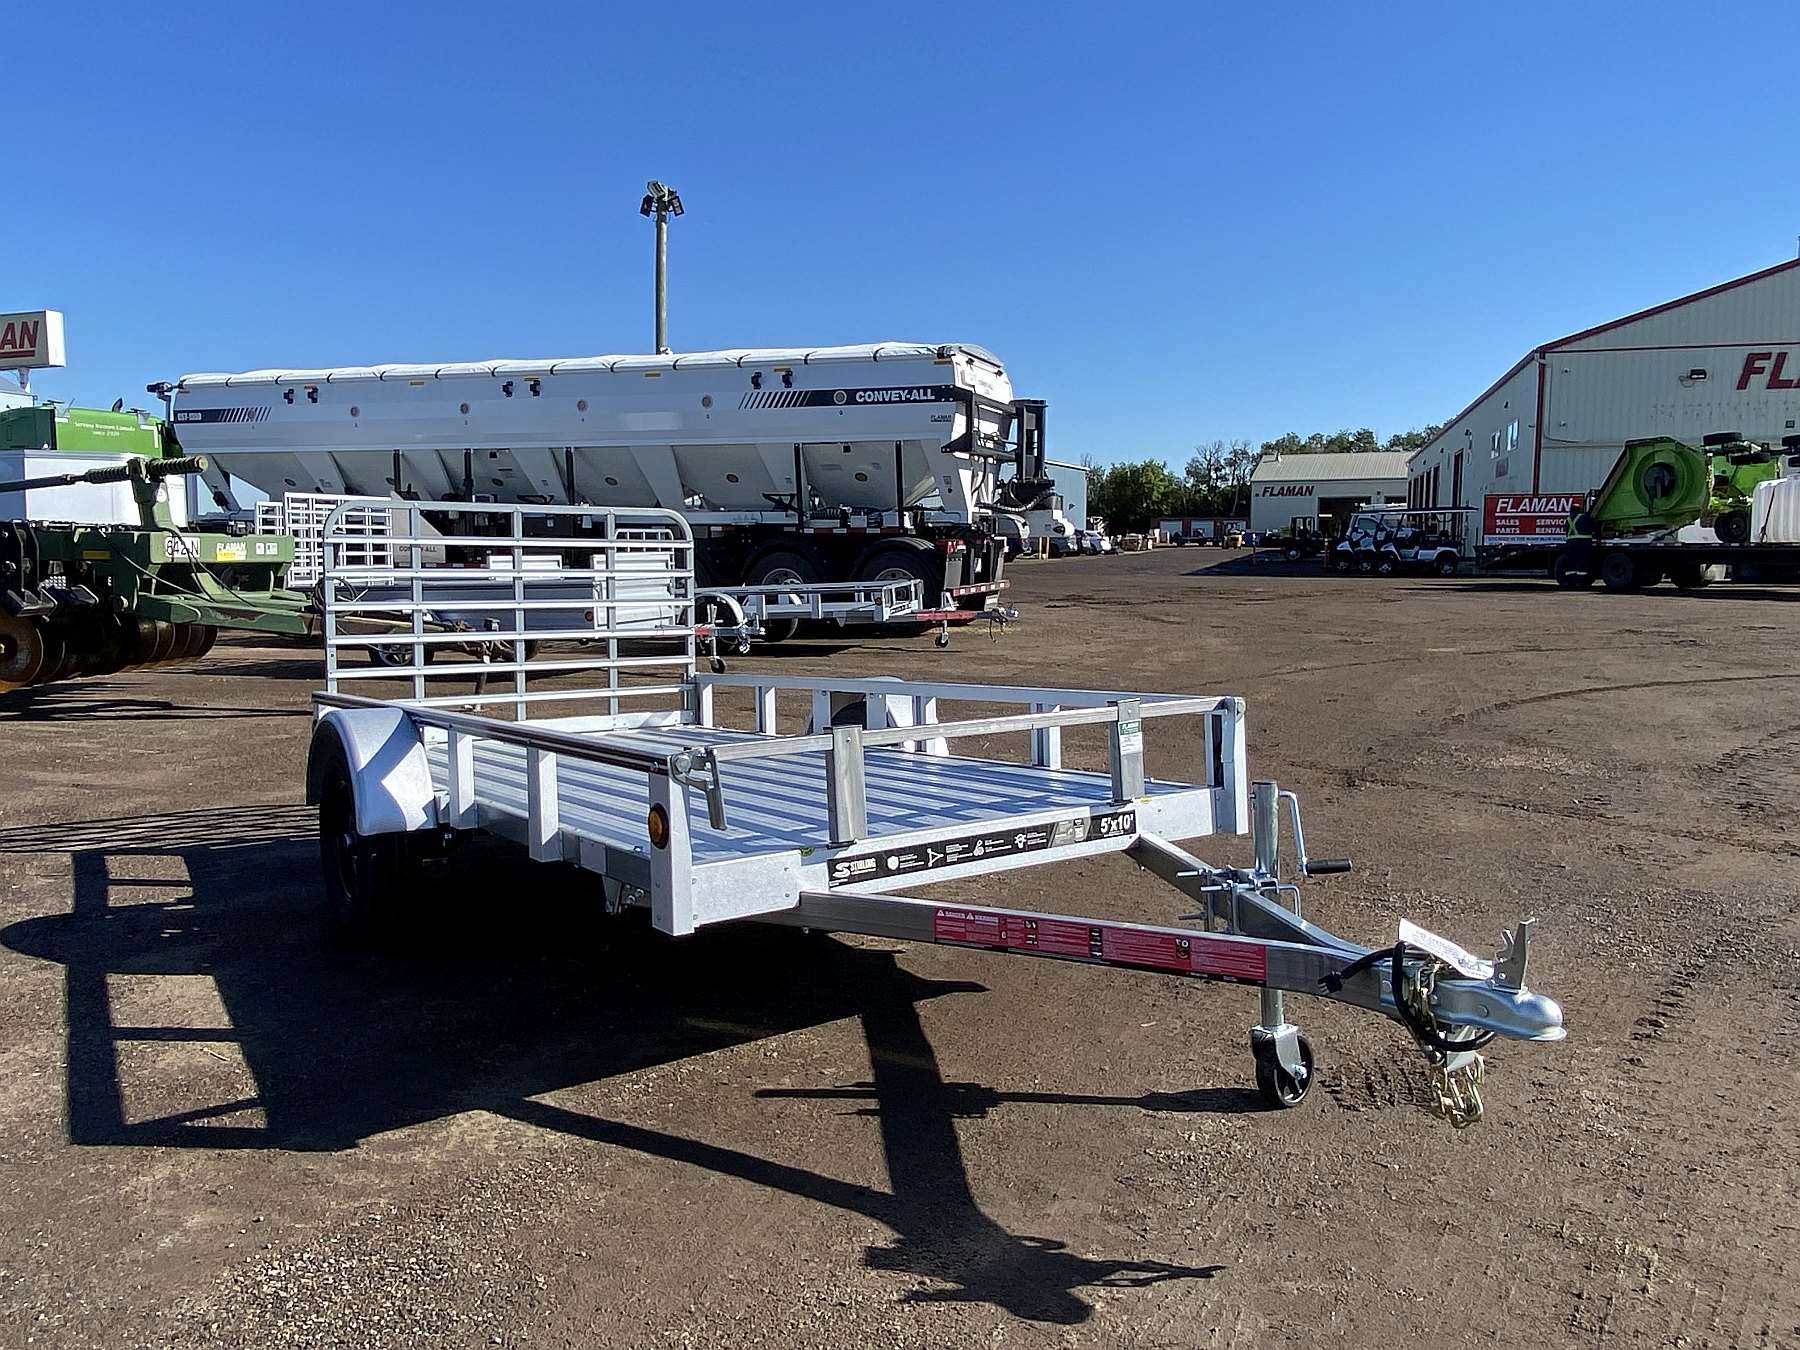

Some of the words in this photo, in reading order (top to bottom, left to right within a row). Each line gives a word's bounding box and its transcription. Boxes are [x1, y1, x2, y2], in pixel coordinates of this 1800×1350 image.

[0, 320, 40, 350] AN
[1736, 352, 1800, 391] FL
[856, 389, 936, 402] CONVEY-ALL
[1262, 485, 1315, 498] FLAMAN
[1496, 498, 1573, 512] FLAMAN
[1496, 518, 1520, 526] SALES
[1536, 518, 1567, 526] SERVIC
[1536, 526, 1567, 534] RENTAL
